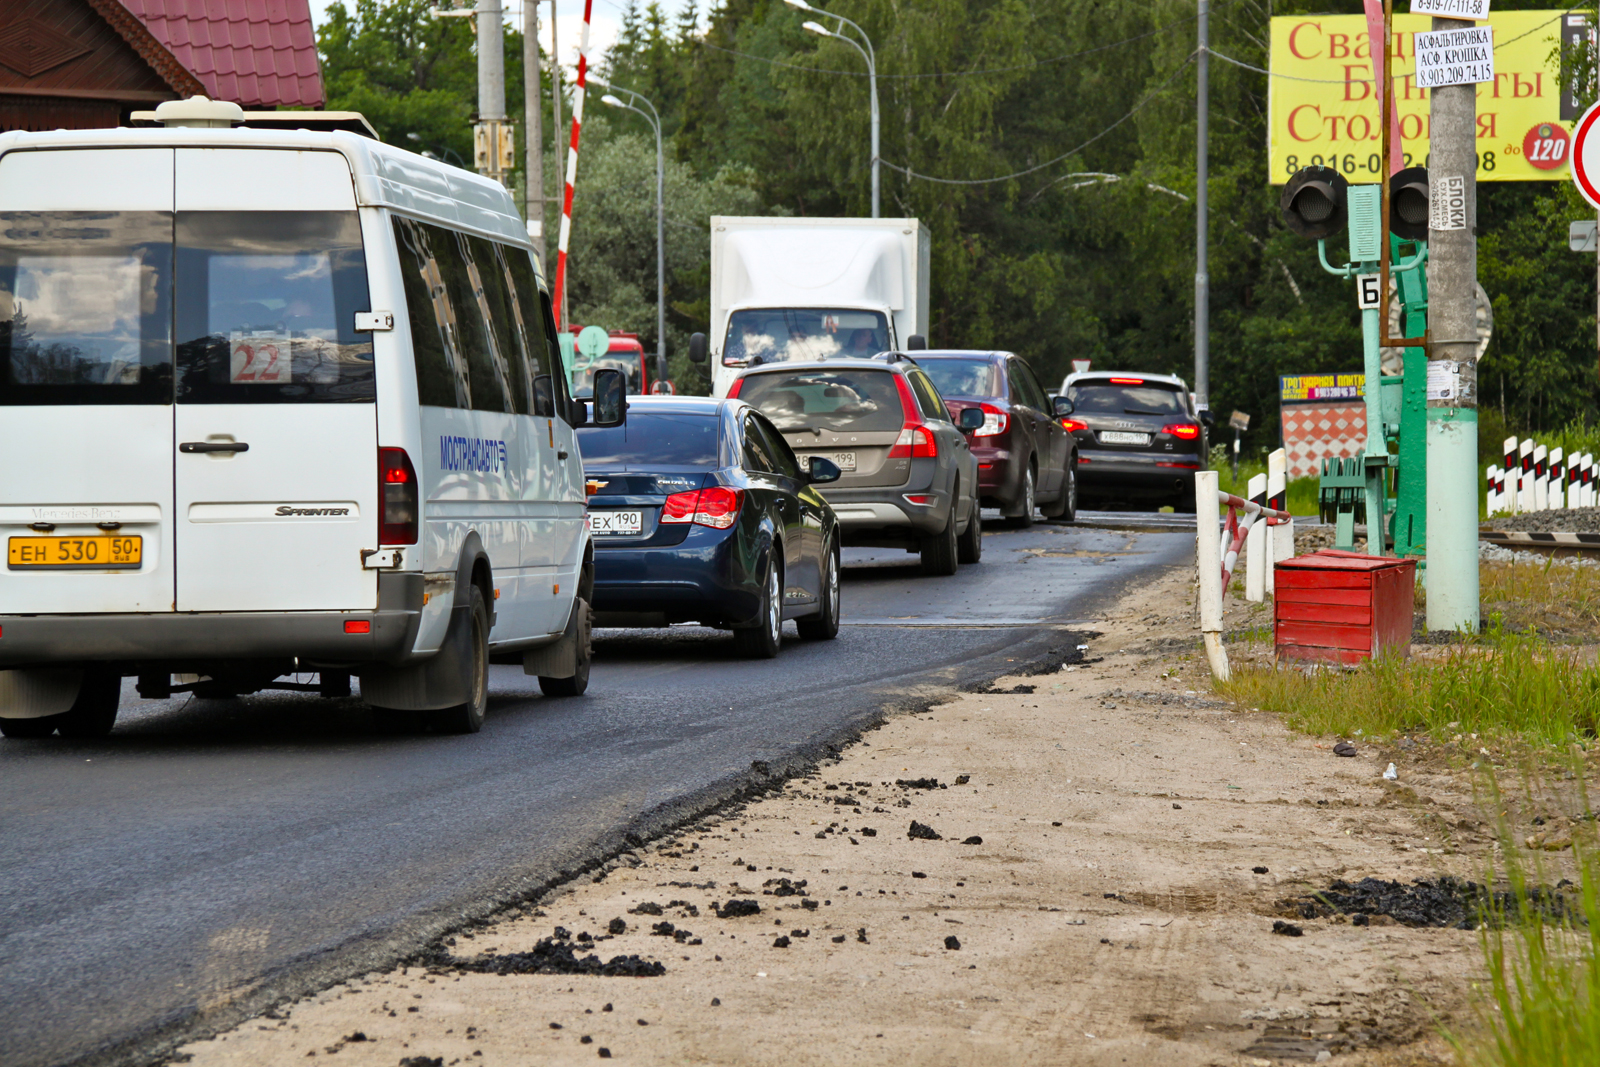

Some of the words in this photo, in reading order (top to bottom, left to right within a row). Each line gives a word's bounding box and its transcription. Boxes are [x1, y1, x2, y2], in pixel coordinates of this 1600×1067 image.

[1418, 29, 1489, 50] АСФАЛЬТИРОВКА
[1421, 51, 1443, 67] АСФ.
[1445, 46, 1488, 64] КРОШКА
[1420, 63, 1492, 87] 8.903.209.74.15
[1529, 138, 1565, 161] 120
[1448, 178, 1465, 228] БЛОКИ
[1362, 278, 1379, 304] Б
[233, 344, 281, 381] 22
[440, 435, 499, 473] МОСТРАНСАВТО
[835, 453, 853, 463] 199
[32, 507, 121, 519] Mercedes-Benz
[615, 513, 637, 525] 190
[57, 540, 98, 561] 530
[112, 538, 133, 555] 50
